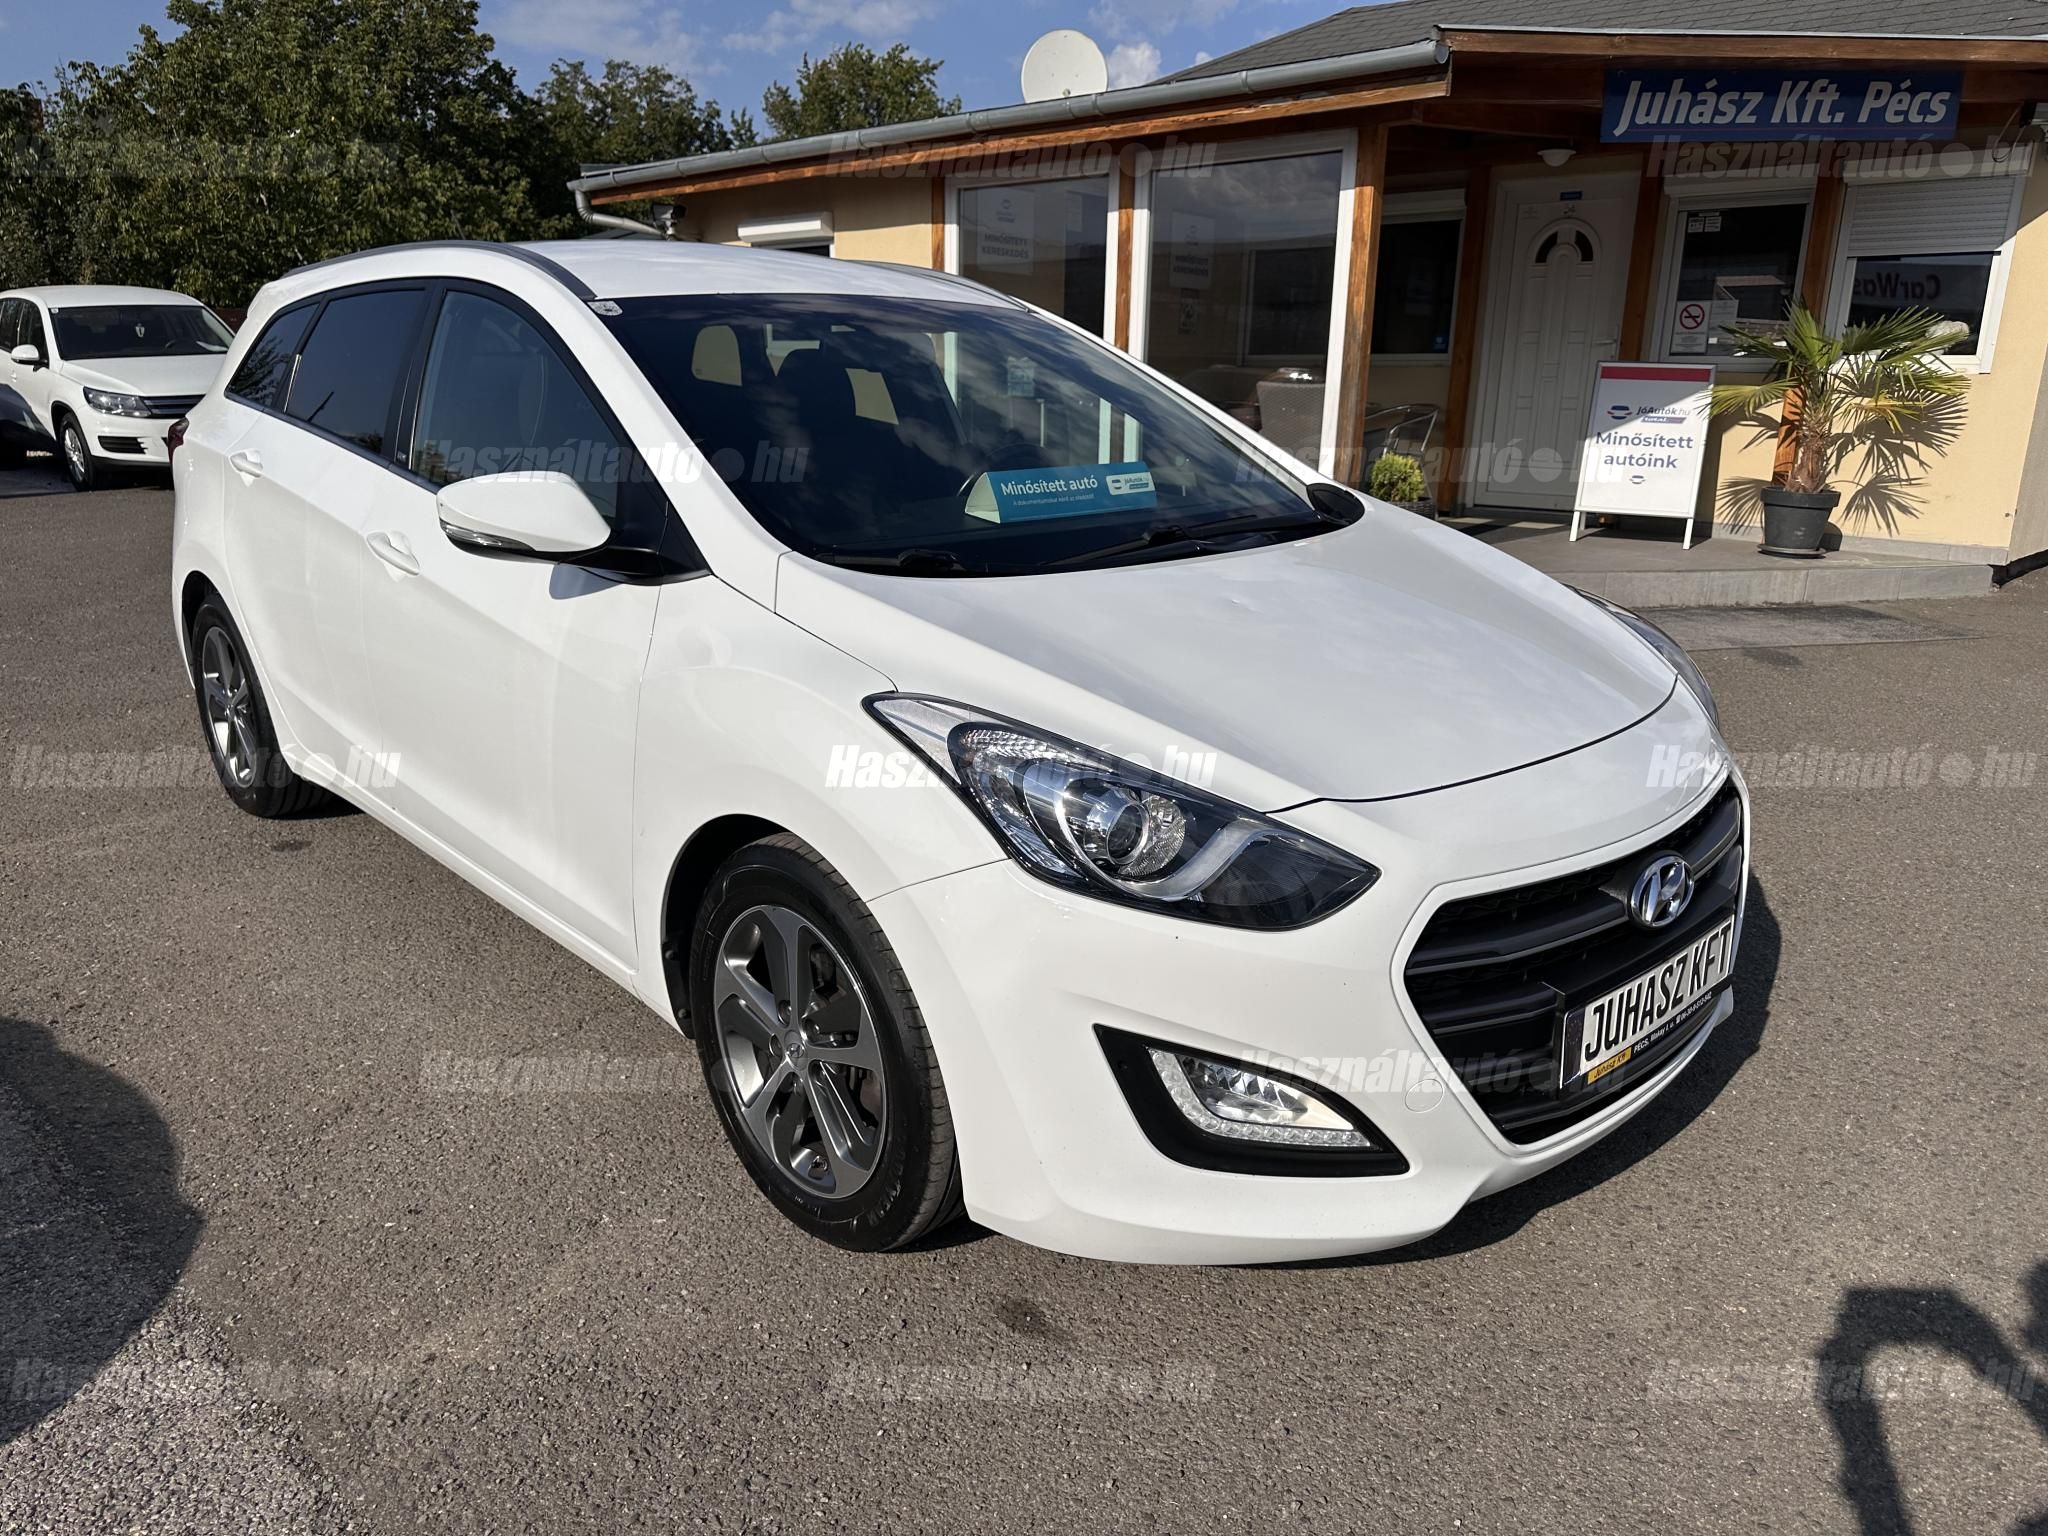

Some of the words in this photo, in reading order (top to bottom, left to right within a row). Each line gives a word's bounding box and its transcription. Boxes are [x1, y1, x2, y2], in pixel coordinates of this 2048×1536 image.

[1613, 77, 1762, 137] Juhász
[1770, 79, 1845, 124] Kft.
[1858, 77, 1952, 124] Pécs
[1596, 431, 1694, 449] Minősített
[1603, 453, 1678, 469] autóink
[1000, 475, 1068, 496] Minősített
[1070, 474, 1099, 491] autó
[1584, 952, 1689, 1062] JUHASZ
[1688, 921, 1732, 997] KFT
